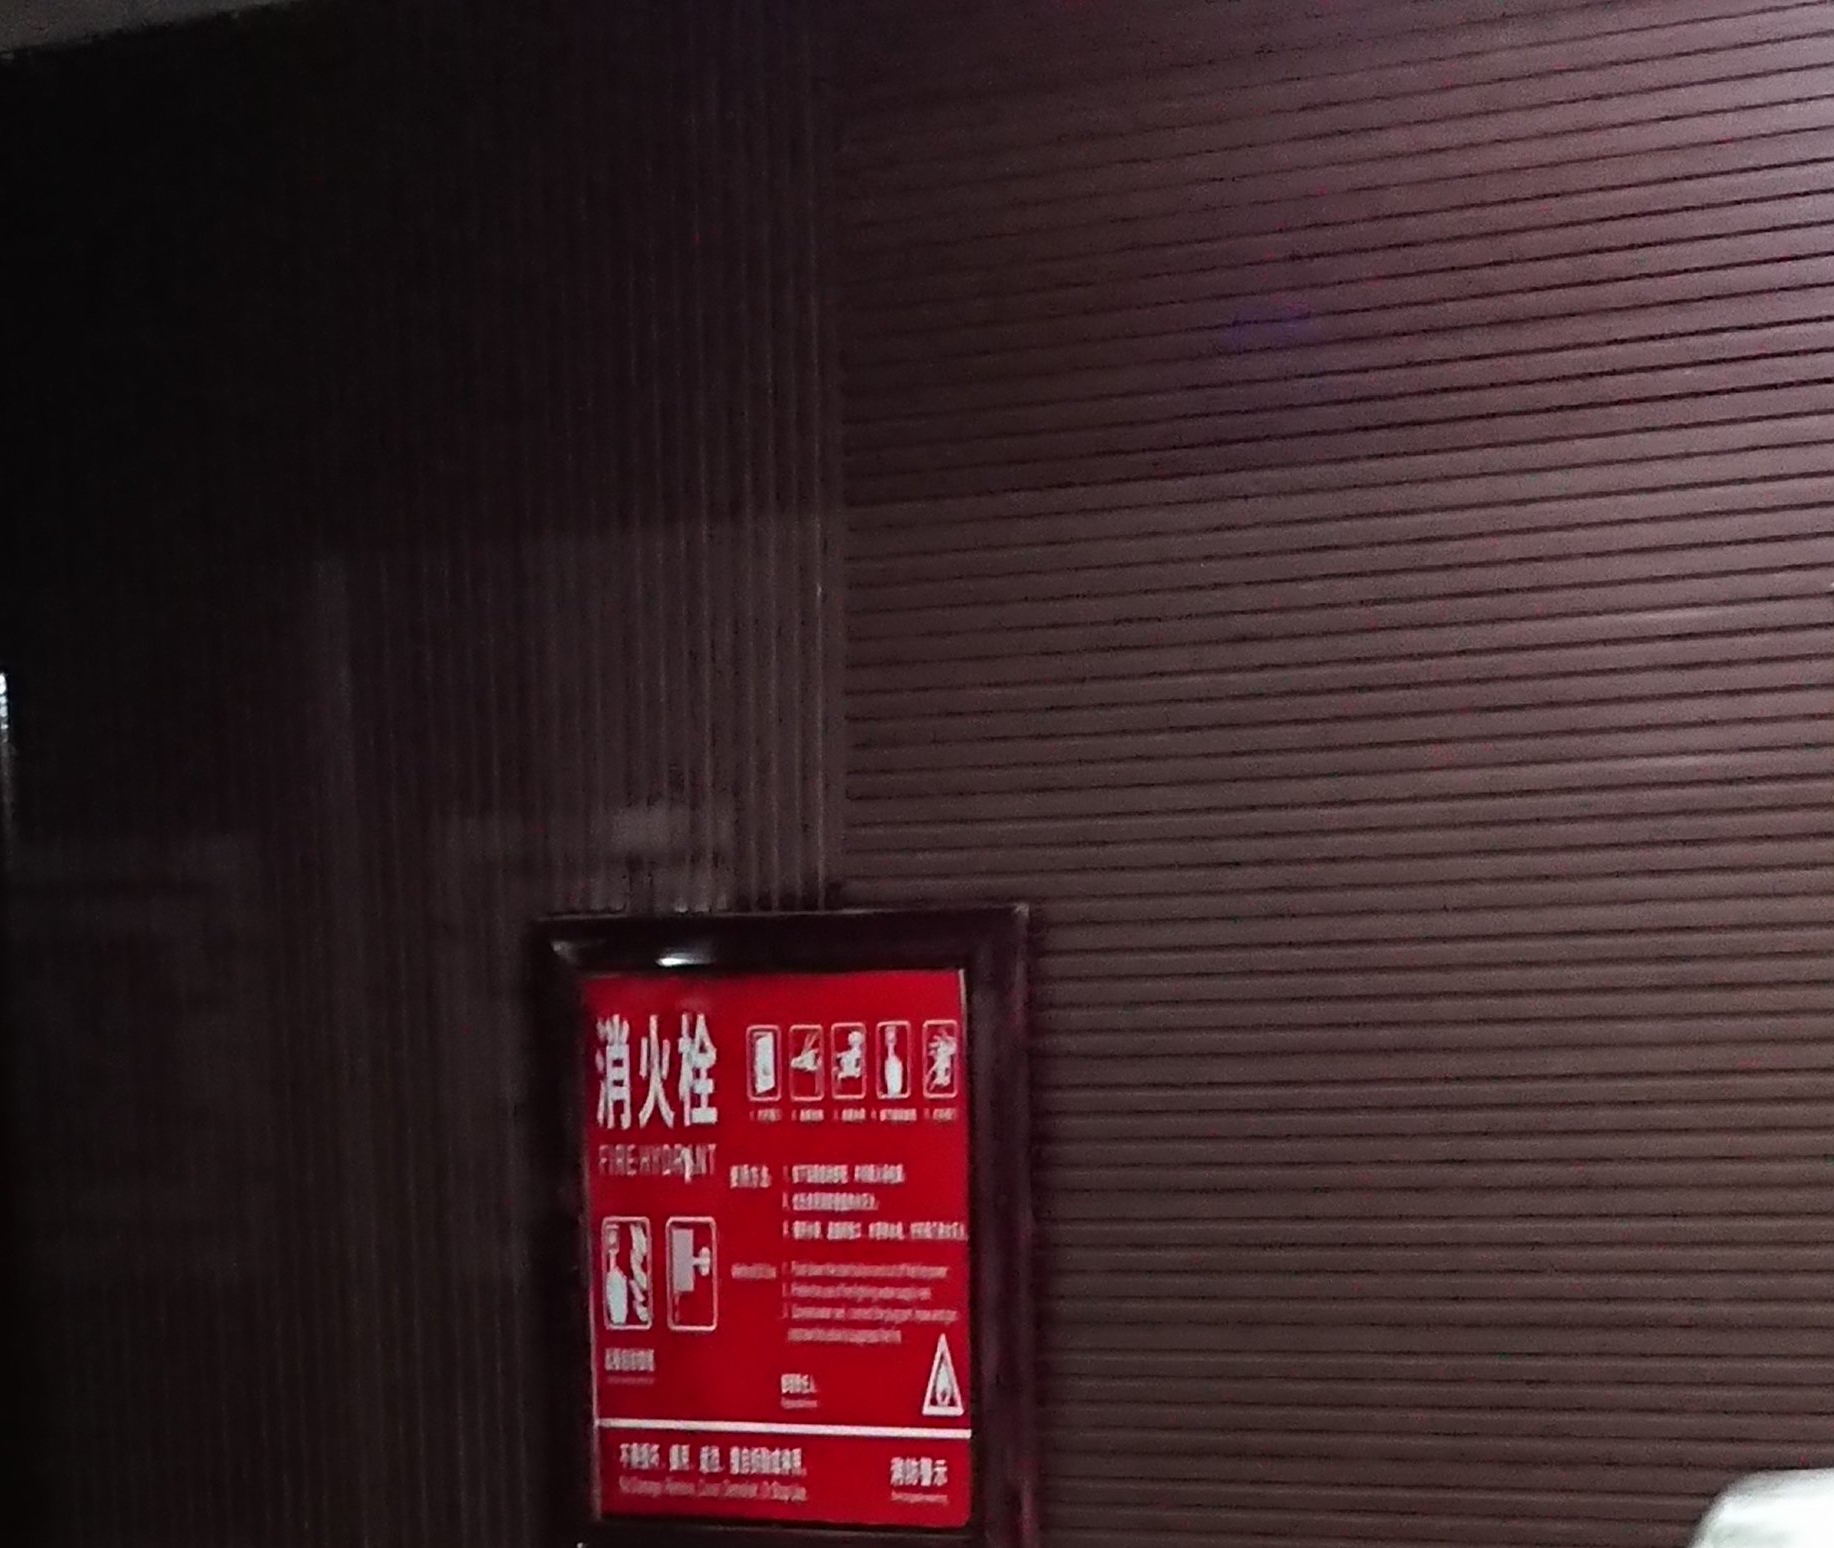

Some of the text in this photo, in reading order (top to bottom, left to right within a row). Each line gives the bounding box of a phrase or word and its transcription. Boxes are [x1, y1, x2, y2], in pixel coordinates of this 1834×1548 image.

[596, 1014, 719, 1131] 消火栓
[598, 1145, 636, 1176] FIRE
